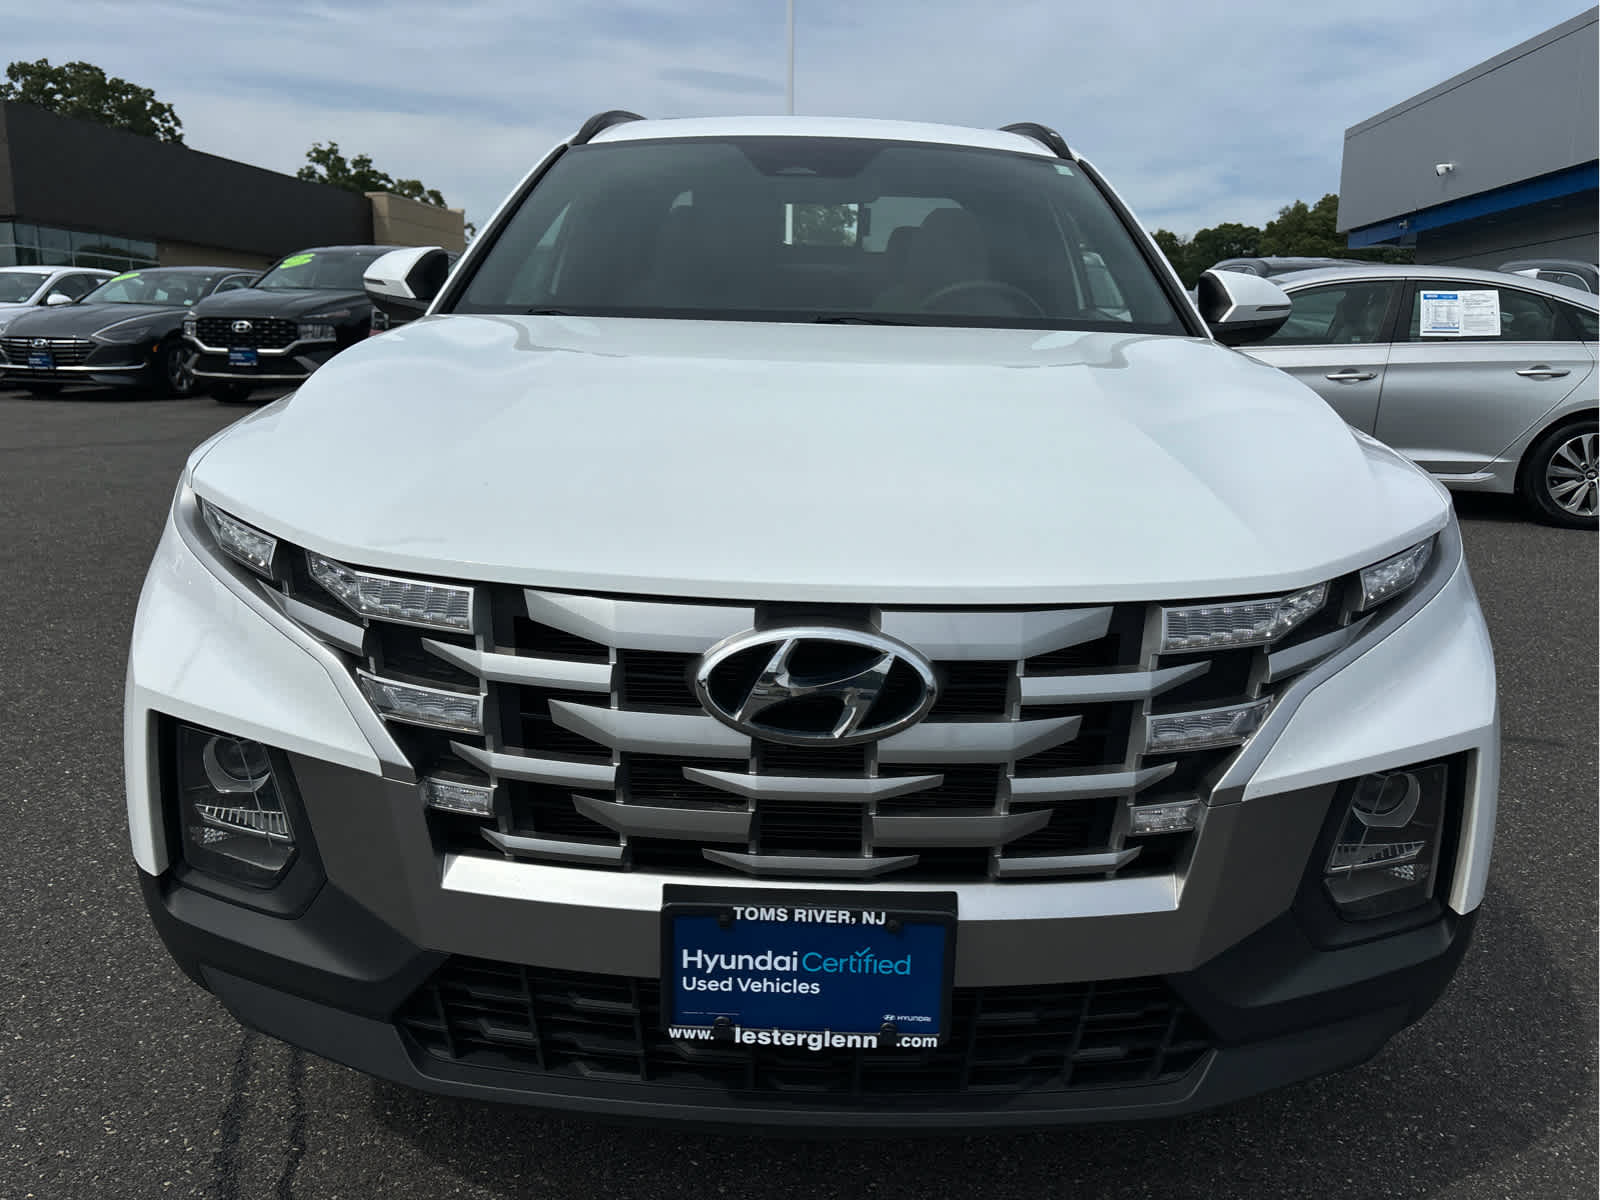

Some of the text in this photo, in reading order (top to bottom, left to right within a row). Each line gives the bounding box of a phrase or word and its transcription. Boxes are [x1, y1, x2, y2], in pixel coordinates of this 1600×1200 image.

[733, 906, 887, 925] TOMS RIVER, NJ
[682, 947, 912, 975] Hyundai Certified
[682, 976, 821, 994] Used Vehicles
[668, 1026, 938, 1050] www. lesterglenn .com
